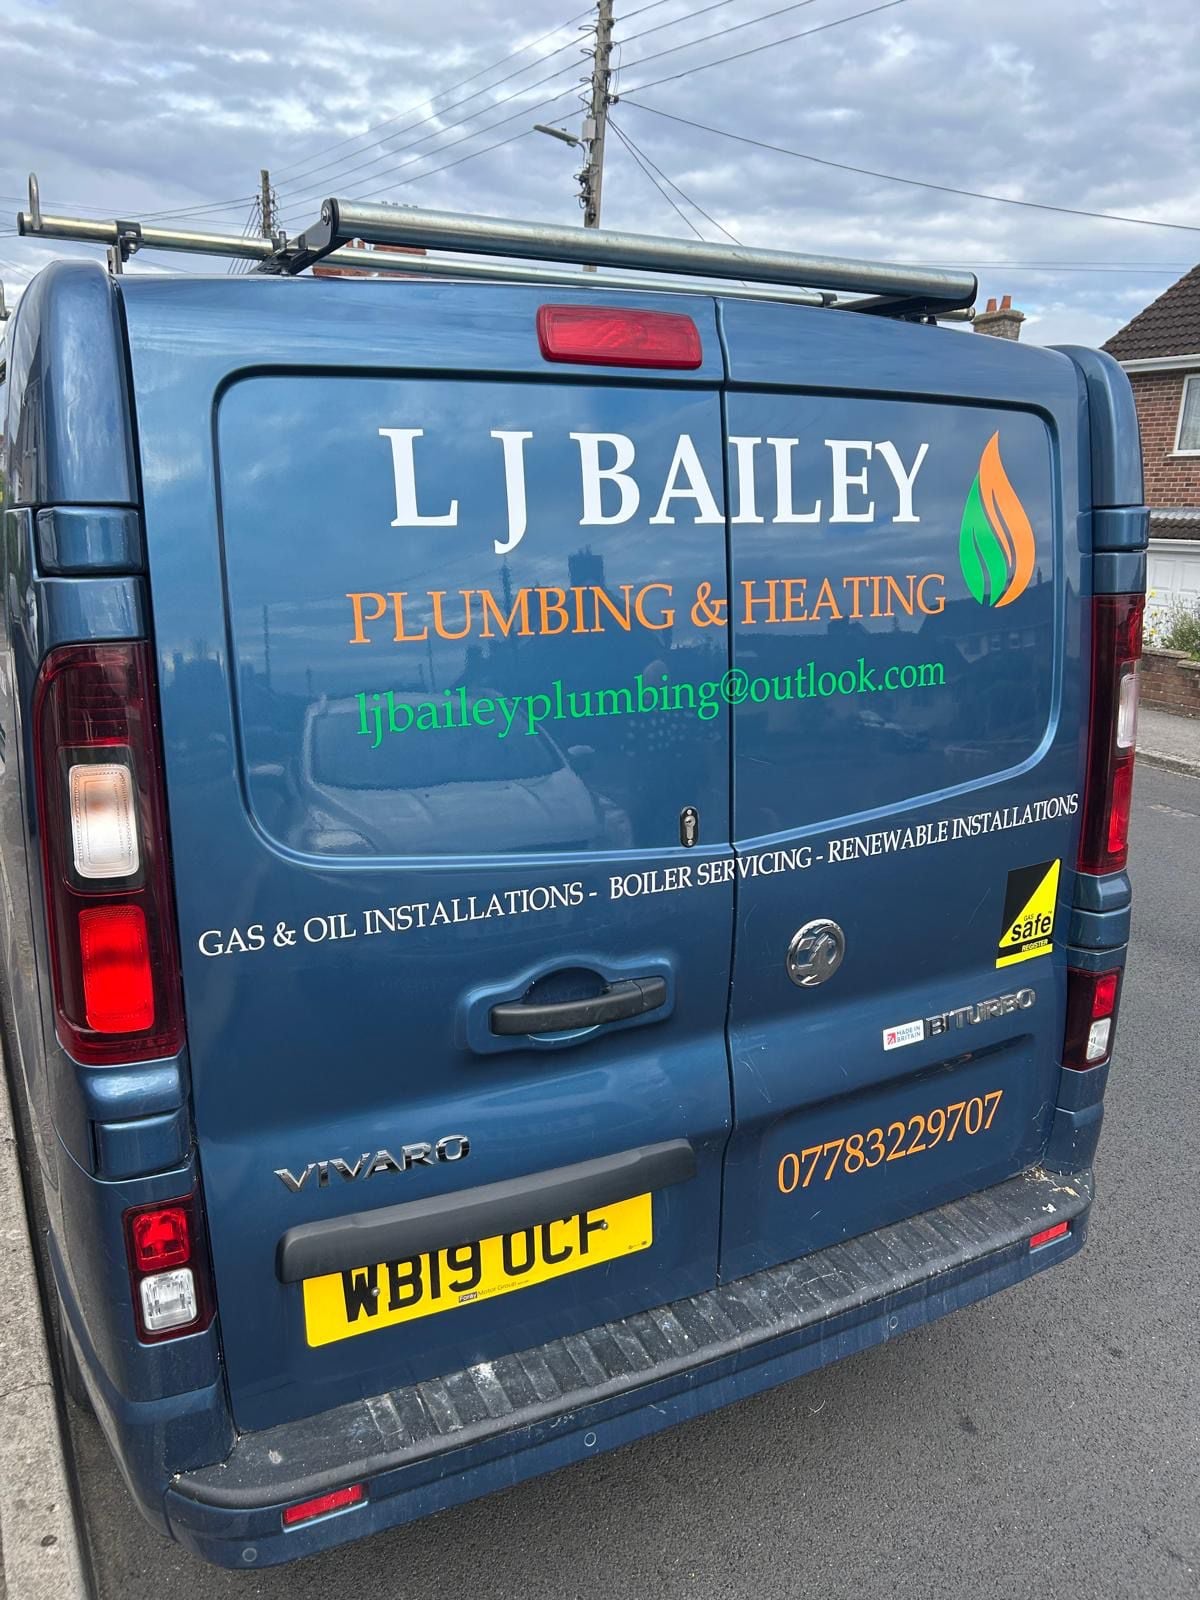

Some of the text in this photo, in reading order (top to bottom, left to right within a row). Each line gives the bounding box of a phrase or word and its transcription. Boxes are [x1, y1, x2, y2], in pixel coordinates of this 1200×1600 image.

[378, 428, 930, 555] L J BAILEY
[345, 573, 946, 644] PLUMBING & HEATING
[355, 658, 946, 748] ljbaileyplumbing@outlook.com
[198, 925, 266, 957] GAS
[272, 921, 297, 948] &
[303, 913, 357, 944] OIL
[363, 881, 584, 937] INSTALLATIONS
[609, 866, 694, 899] BOILER
[697, 846, 812, 886] SERVICING
[828, 820, 949, 865] RENEWABLE
[952, 793, 1079, 839] INSTALLATIONS
[1010, 912, 1052, 942] safe
[1023, 914, 1034, 922] GAS
[926, 988, 1036, 1036] BITURBO
[273, 1134, 470, 1192] VIVARO
[777, 1089, 1004, 1194] 07783229707
[341, 1211, 607, 1323] WB19 OCF
